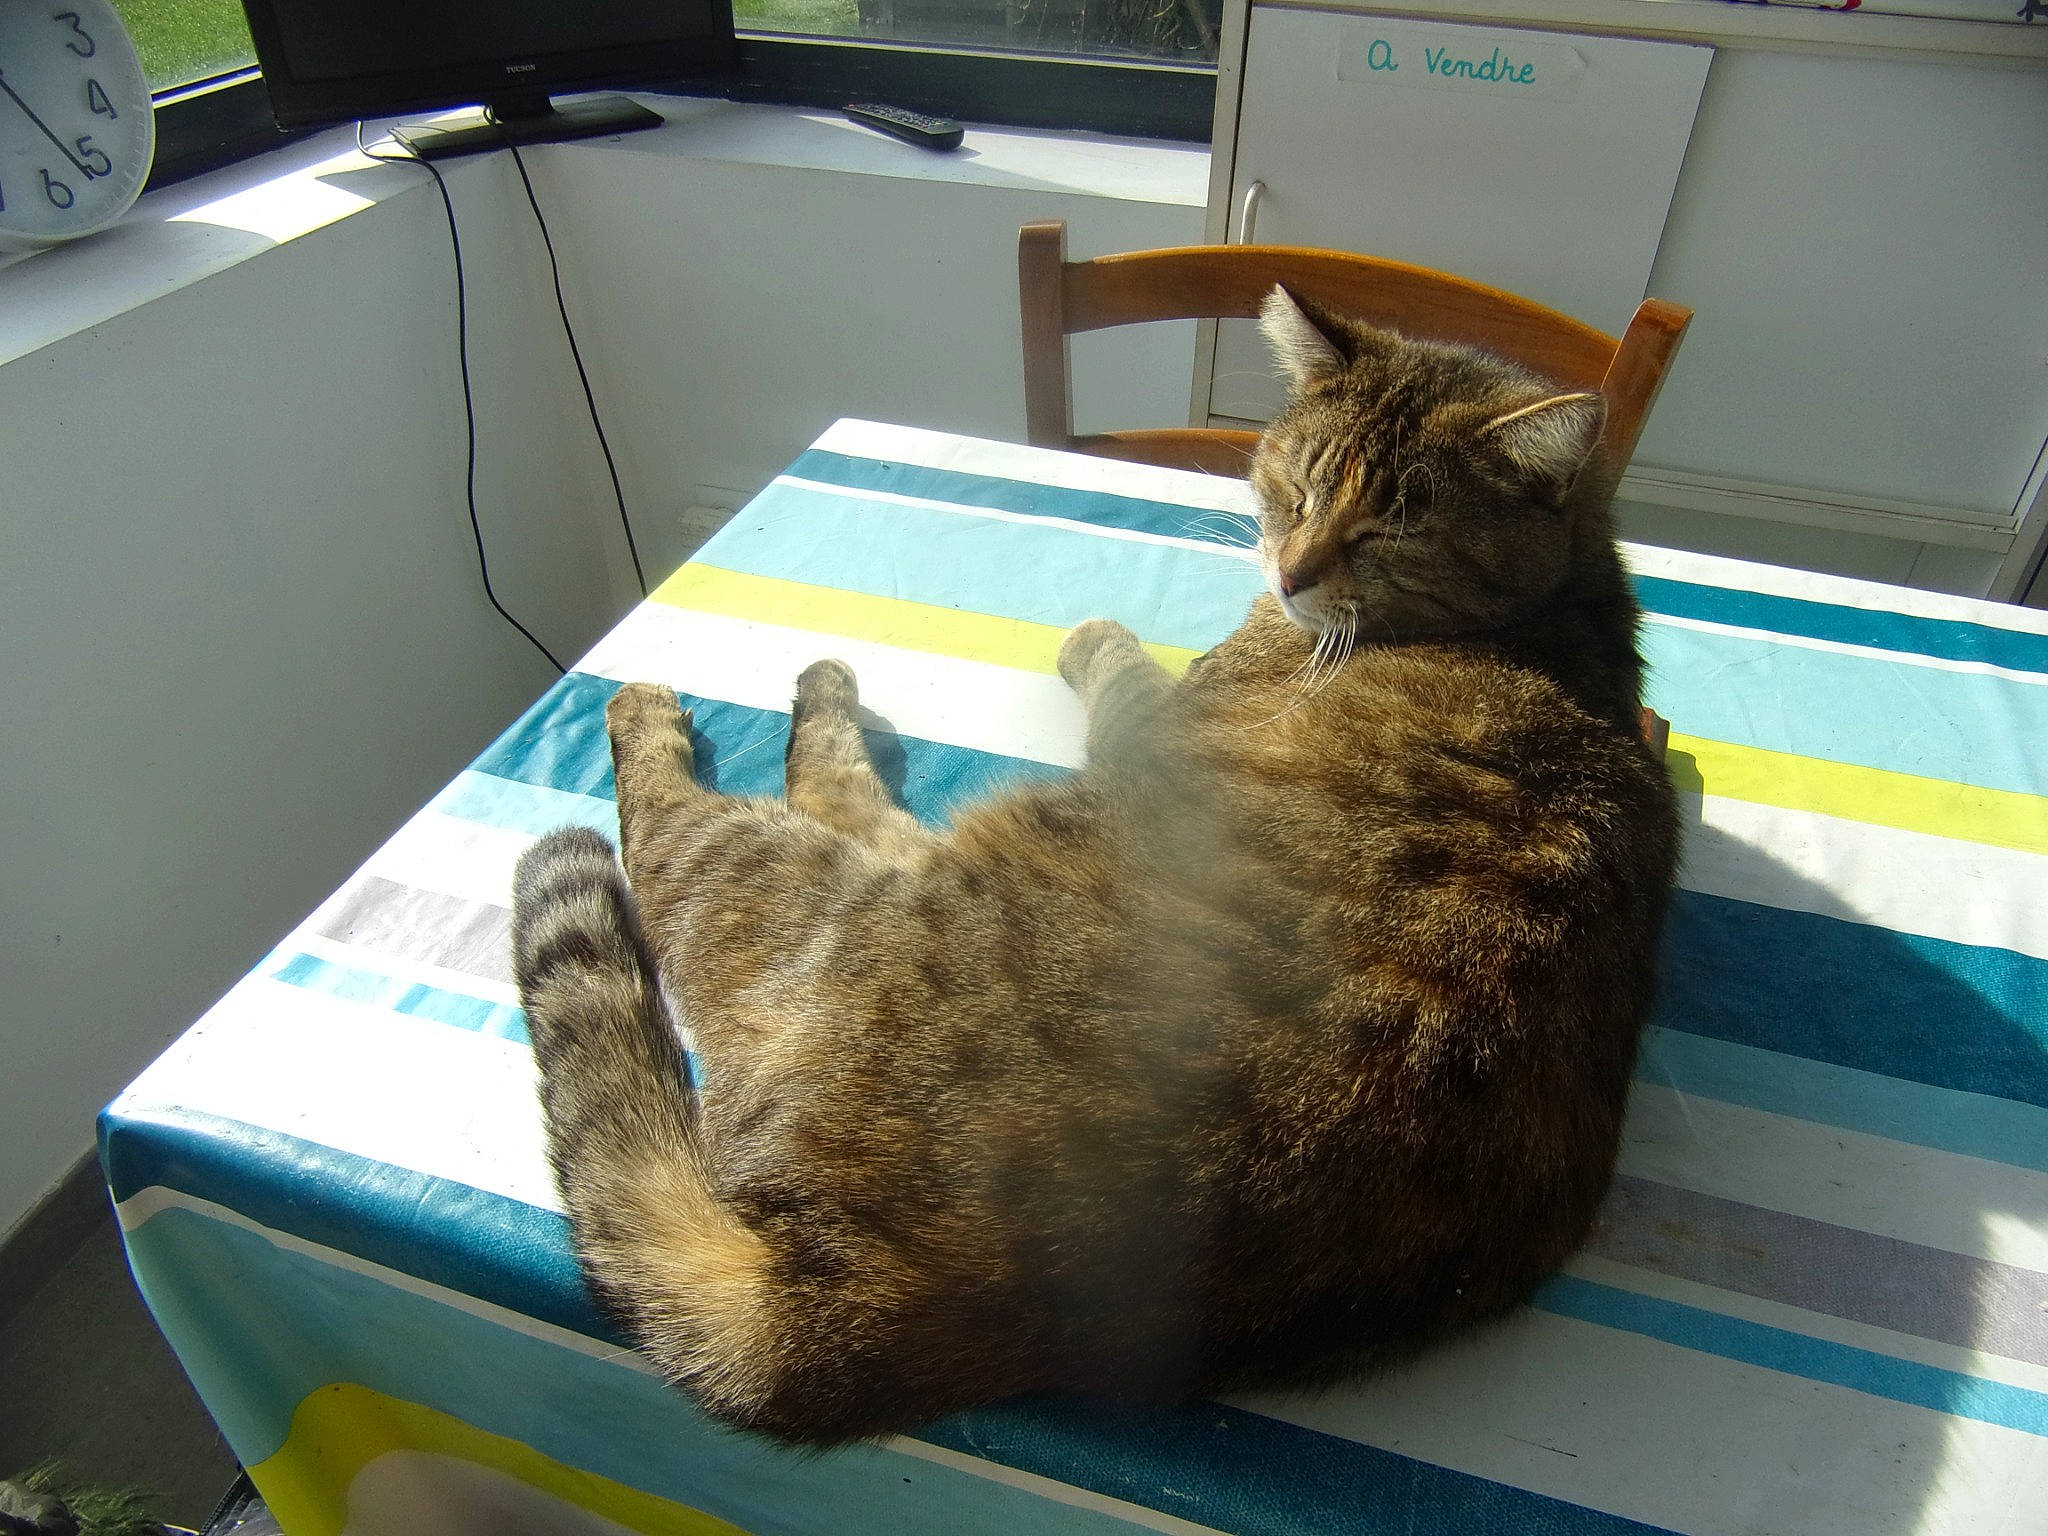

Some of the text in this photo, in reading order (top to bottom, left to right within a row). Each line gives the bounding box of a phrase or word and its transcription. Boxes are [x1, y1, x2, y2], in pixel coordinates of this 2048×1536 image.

[53, 11, 96, 58] 3
[1424, 46, 1537, 85] Vendre
[87, 78, 119, 120] 4
[75, 135, 113, 177] 5
[39, 167, 75, 210] 6
